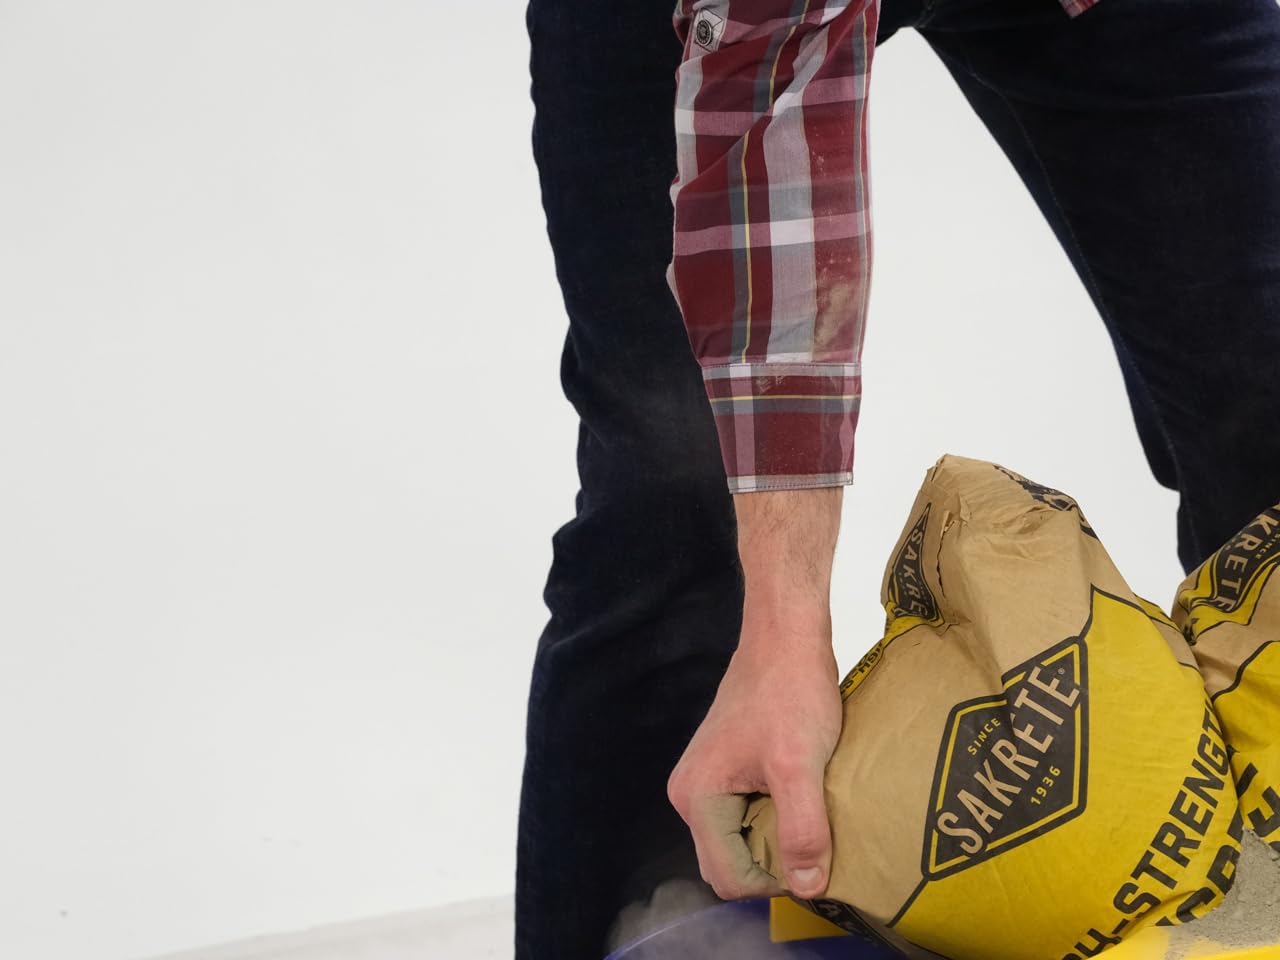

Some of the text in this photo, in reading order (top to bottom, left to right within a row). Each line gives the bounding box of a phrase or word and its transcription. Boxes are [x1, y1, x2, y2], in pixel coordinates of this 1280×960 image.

[896, 529, 927, 616] SAKRE
[937, 665, 1080, 855] SAKRETE
[967, 717, 1001, 756] SINCE
[1030, 765, 1062, 806] 1936
